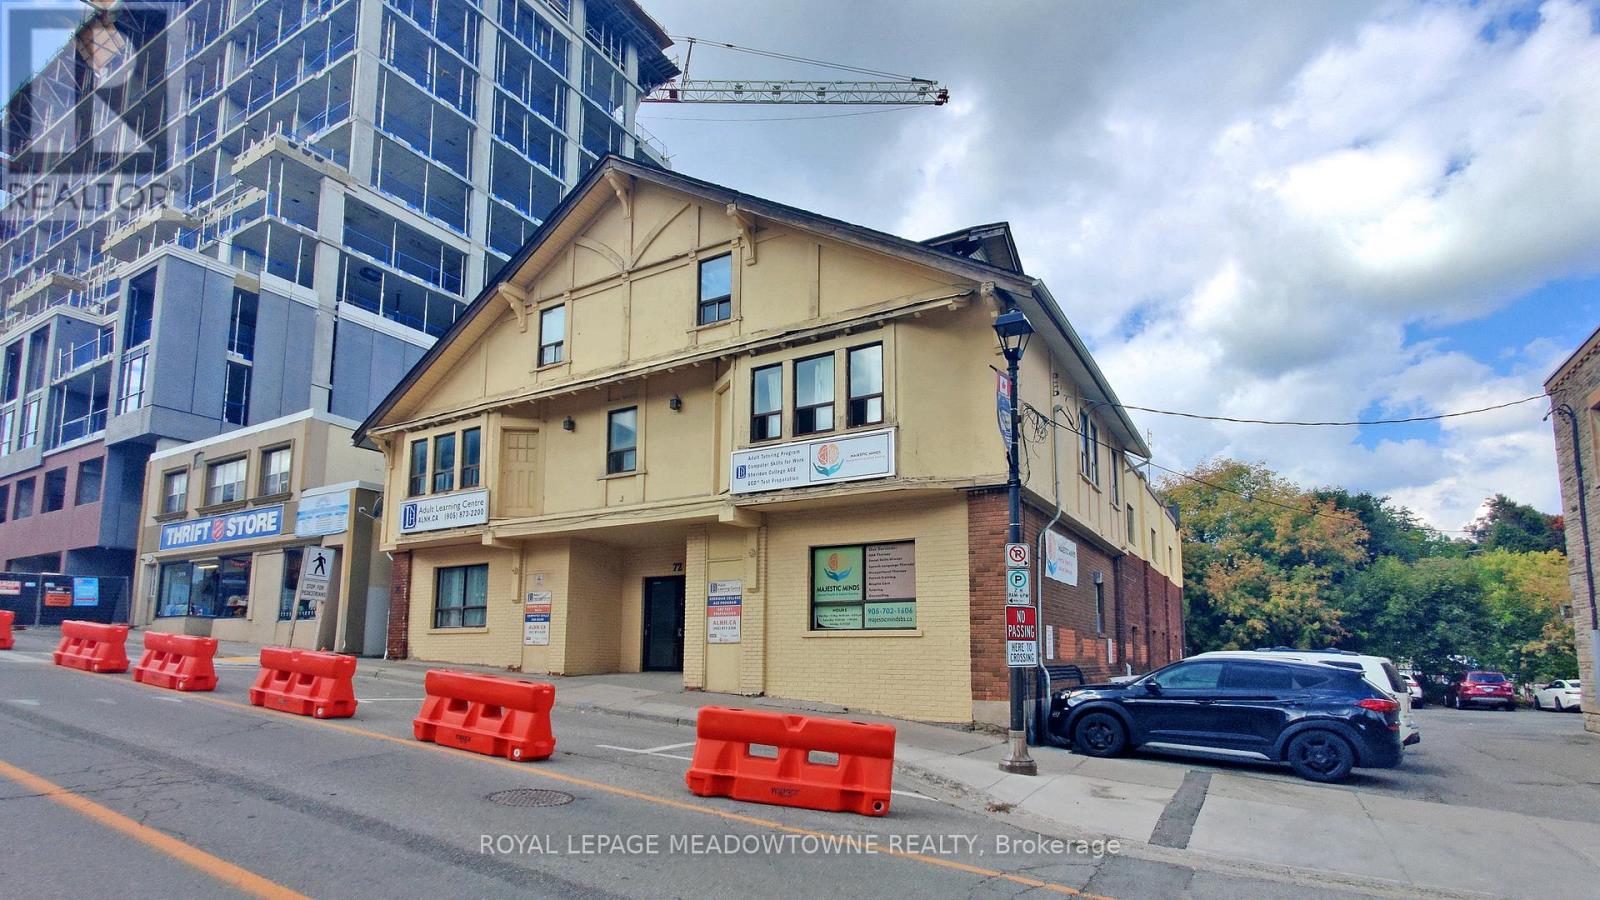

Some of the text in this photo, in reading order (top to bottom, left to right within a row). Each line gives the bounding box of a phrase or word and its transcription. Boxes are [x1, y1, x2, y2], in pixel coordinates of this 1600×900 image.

[781, 449, 801, 457] Program
[418, 499, 485, 514] Adult Learning Centre
[167, 521, 212, 546] THRIFT
[226, 511, 279, 537] STORE
[672, 561, 683, 572] 72
[816, 585, 841, 593] MAJESTIC
[1016, 610, 1026, 623] NO
[1008, 624, 1035, 638] PASSING
[1011, 642, 1033, 652] HERE TO
[1010, 653, 1035, 663] CROSSING
